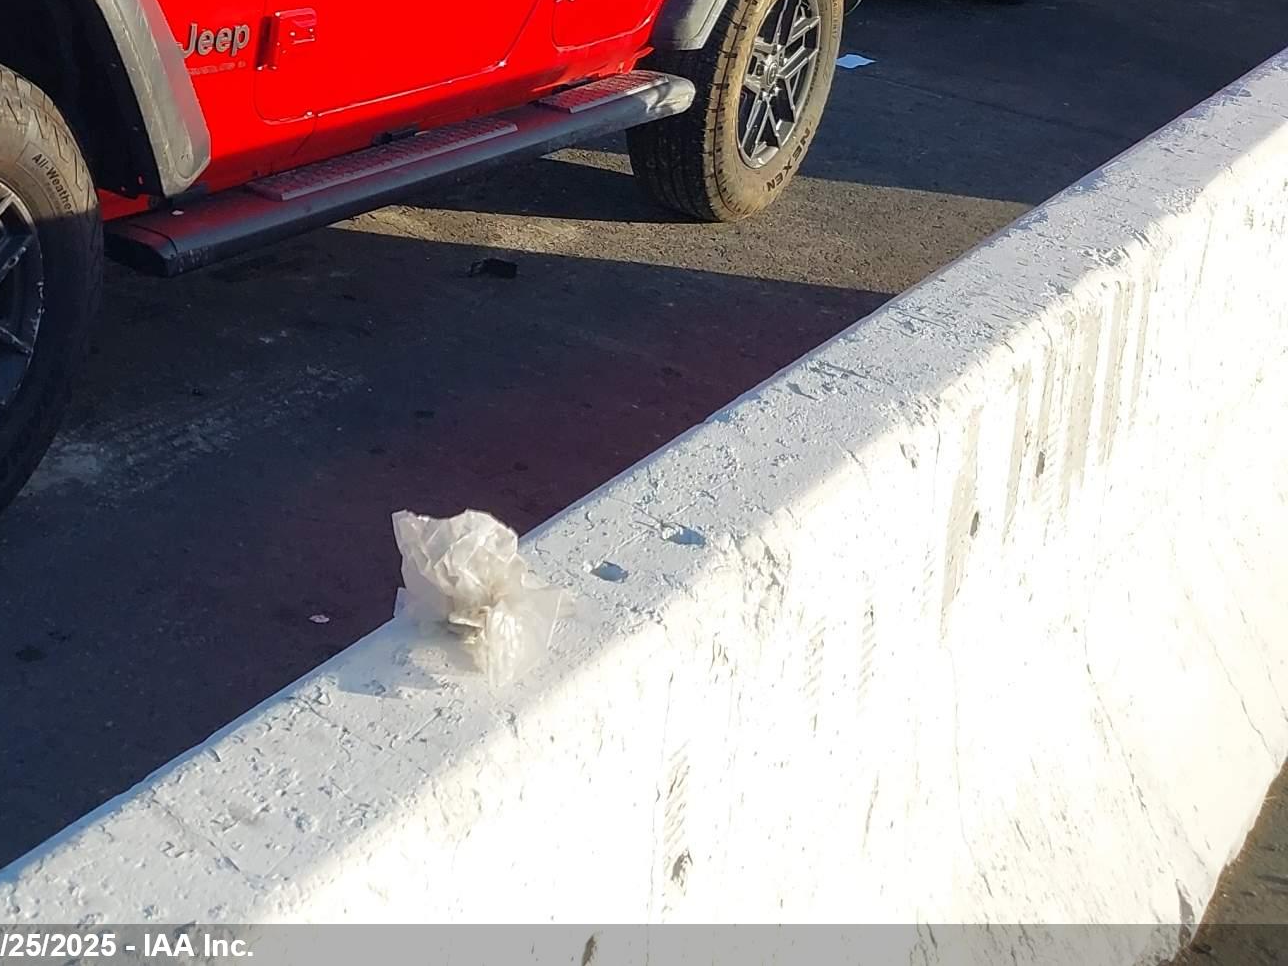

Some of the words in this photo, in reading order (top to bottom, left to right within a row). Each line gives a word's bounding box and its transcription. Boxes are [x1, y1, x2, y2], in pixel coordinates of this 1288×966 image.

[183, 22, 250, 57] Jeep
[32, 153, 74, 215] All-Weather
[766, 127, 811, 192] NEXEN
